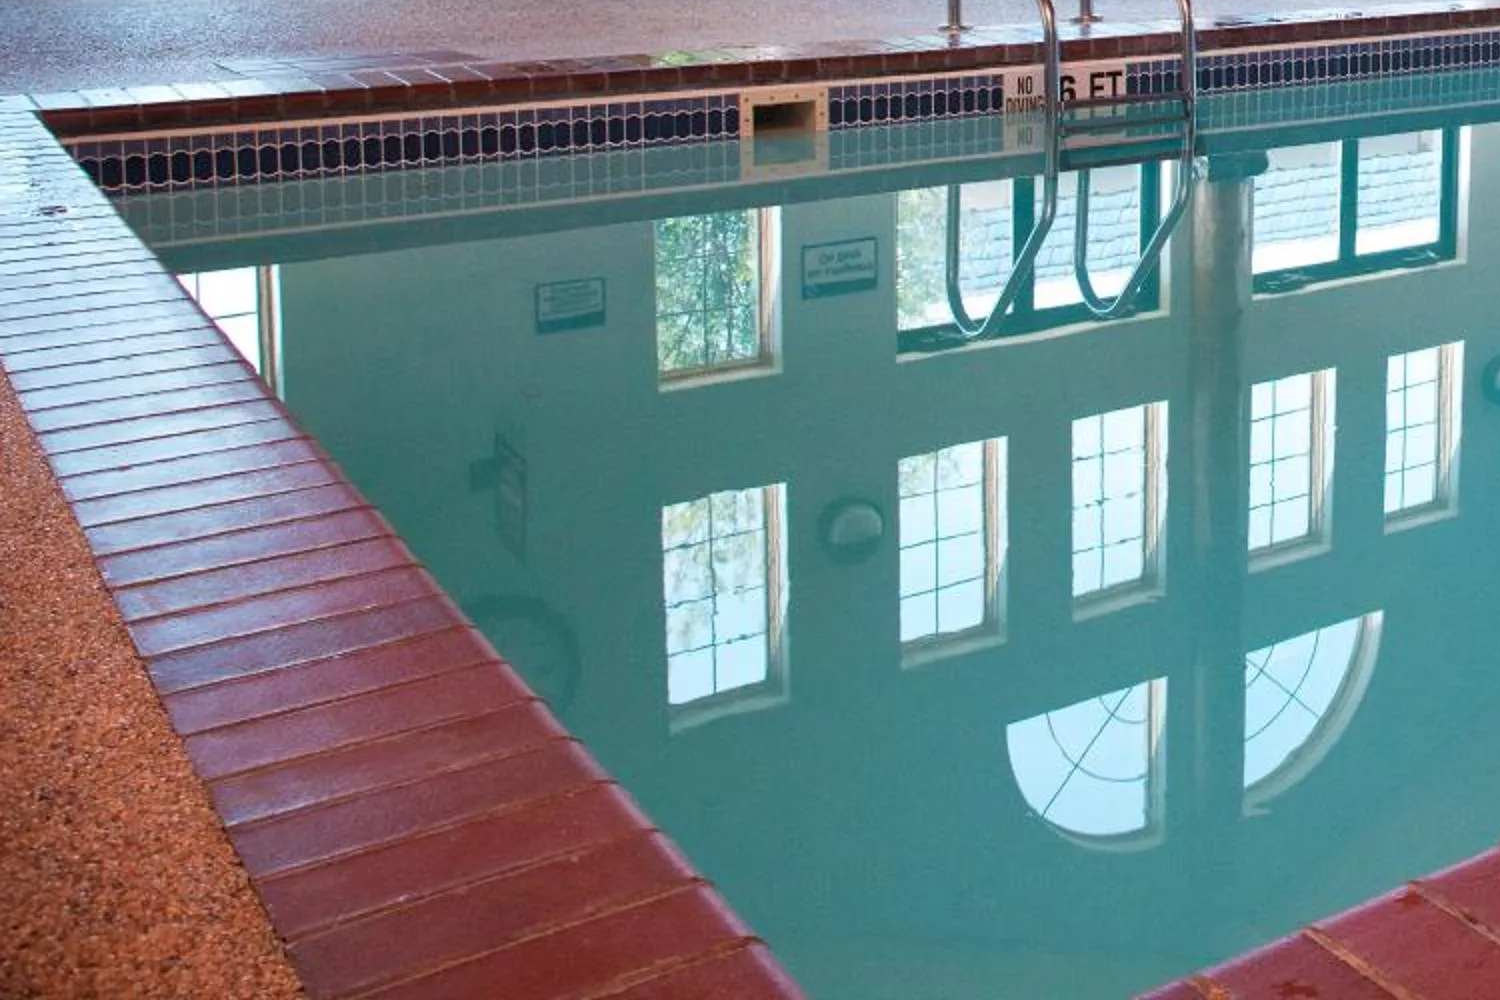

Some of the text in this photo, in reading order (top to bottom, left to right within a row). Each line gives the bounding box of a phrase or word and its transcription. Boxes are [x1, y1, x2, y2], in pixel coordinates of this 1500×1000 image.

[1017, 75, 1033, 95] NO
[1060, 71, 1123, 101] 6 FT
